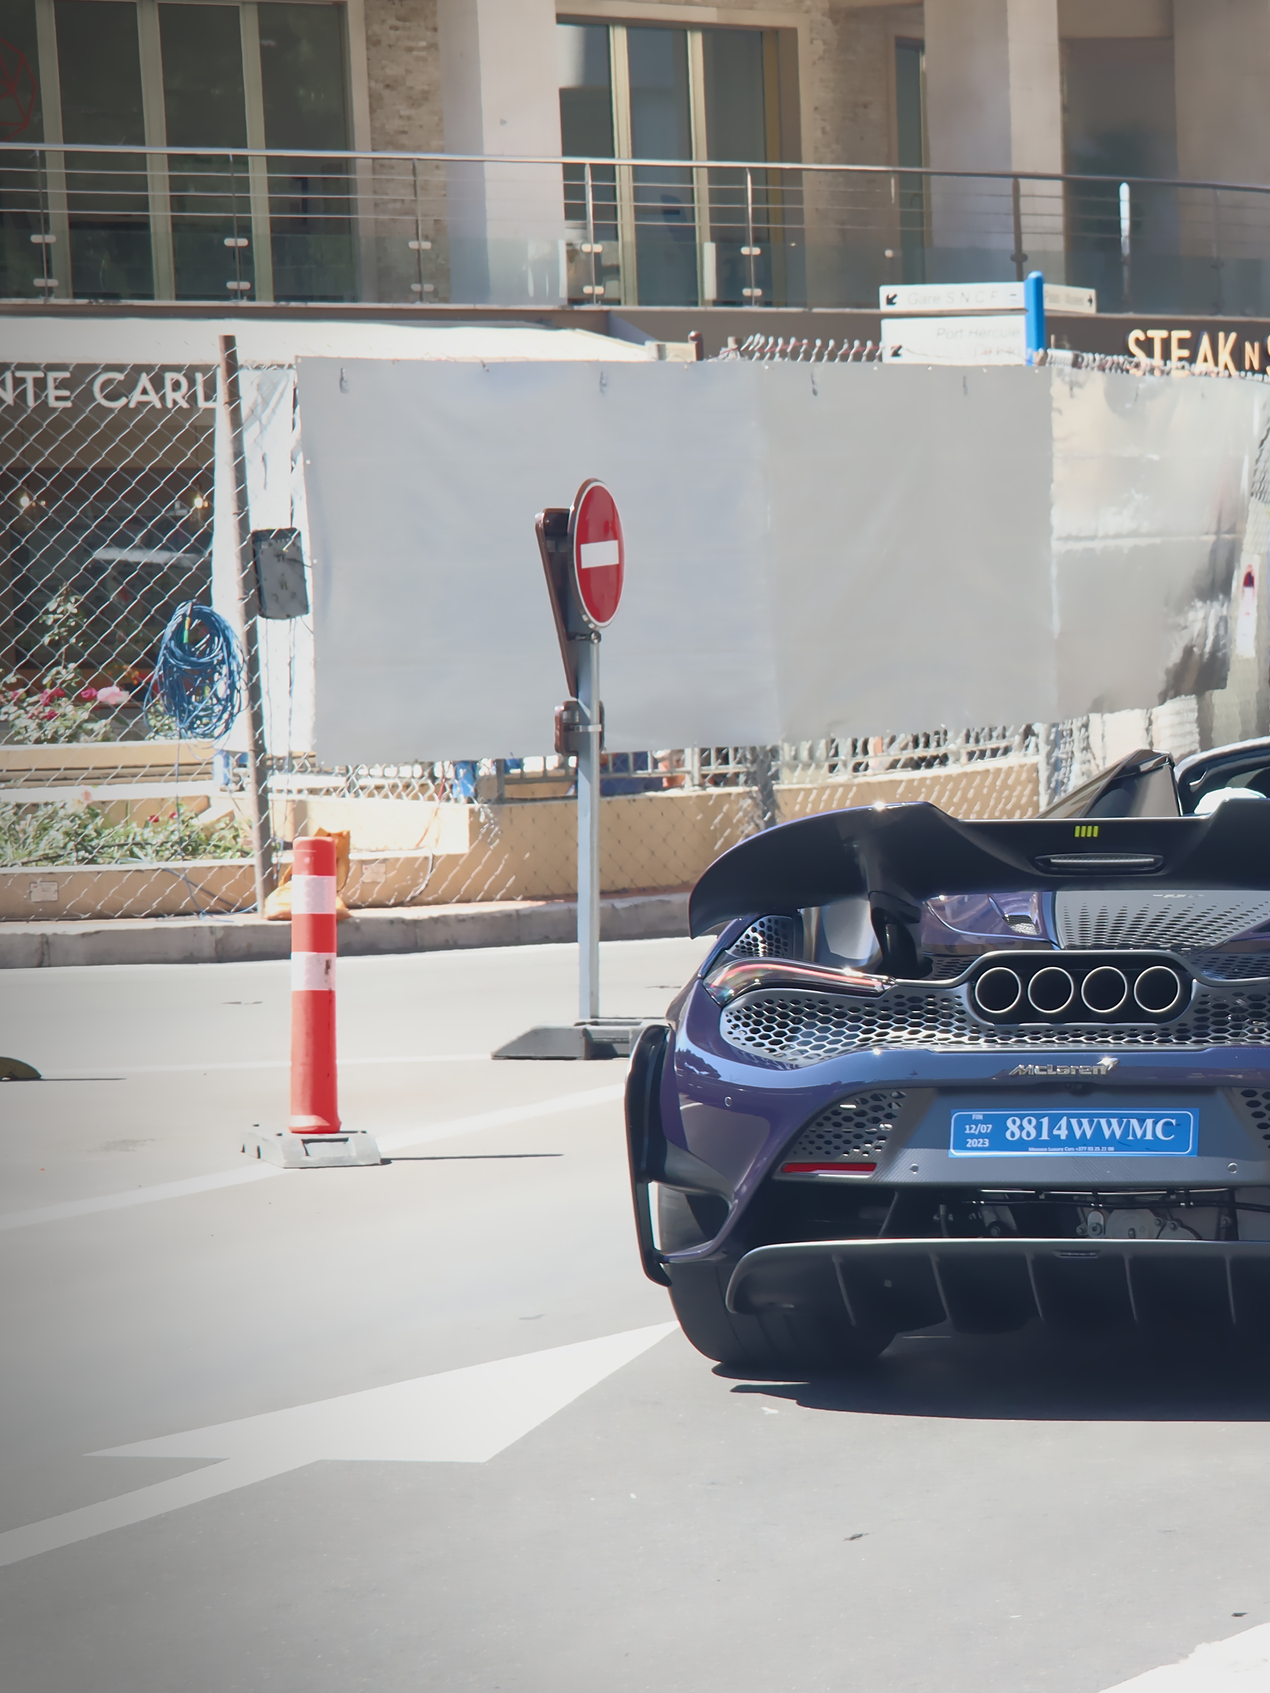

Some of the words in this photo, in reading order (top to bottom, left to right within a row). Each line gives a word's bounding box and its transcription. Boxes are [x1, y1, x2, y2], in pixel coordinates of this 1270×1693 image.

[907, 291, 941, 305] Gare
[936, 327, 963, 340] Port
[968, 326, 1020, 339] Hercule
[1127, 328, 1238, 378] STEAK
[1008, 1064, 1108, 1076] McLaren
[971, 1113, 984, 1121] FIN
[964, 1123, 993, 1135] 12/07
[1005, 1116, 1177, 1141] 8814WWMC
[966, 1138, 990, 1148] 2023
